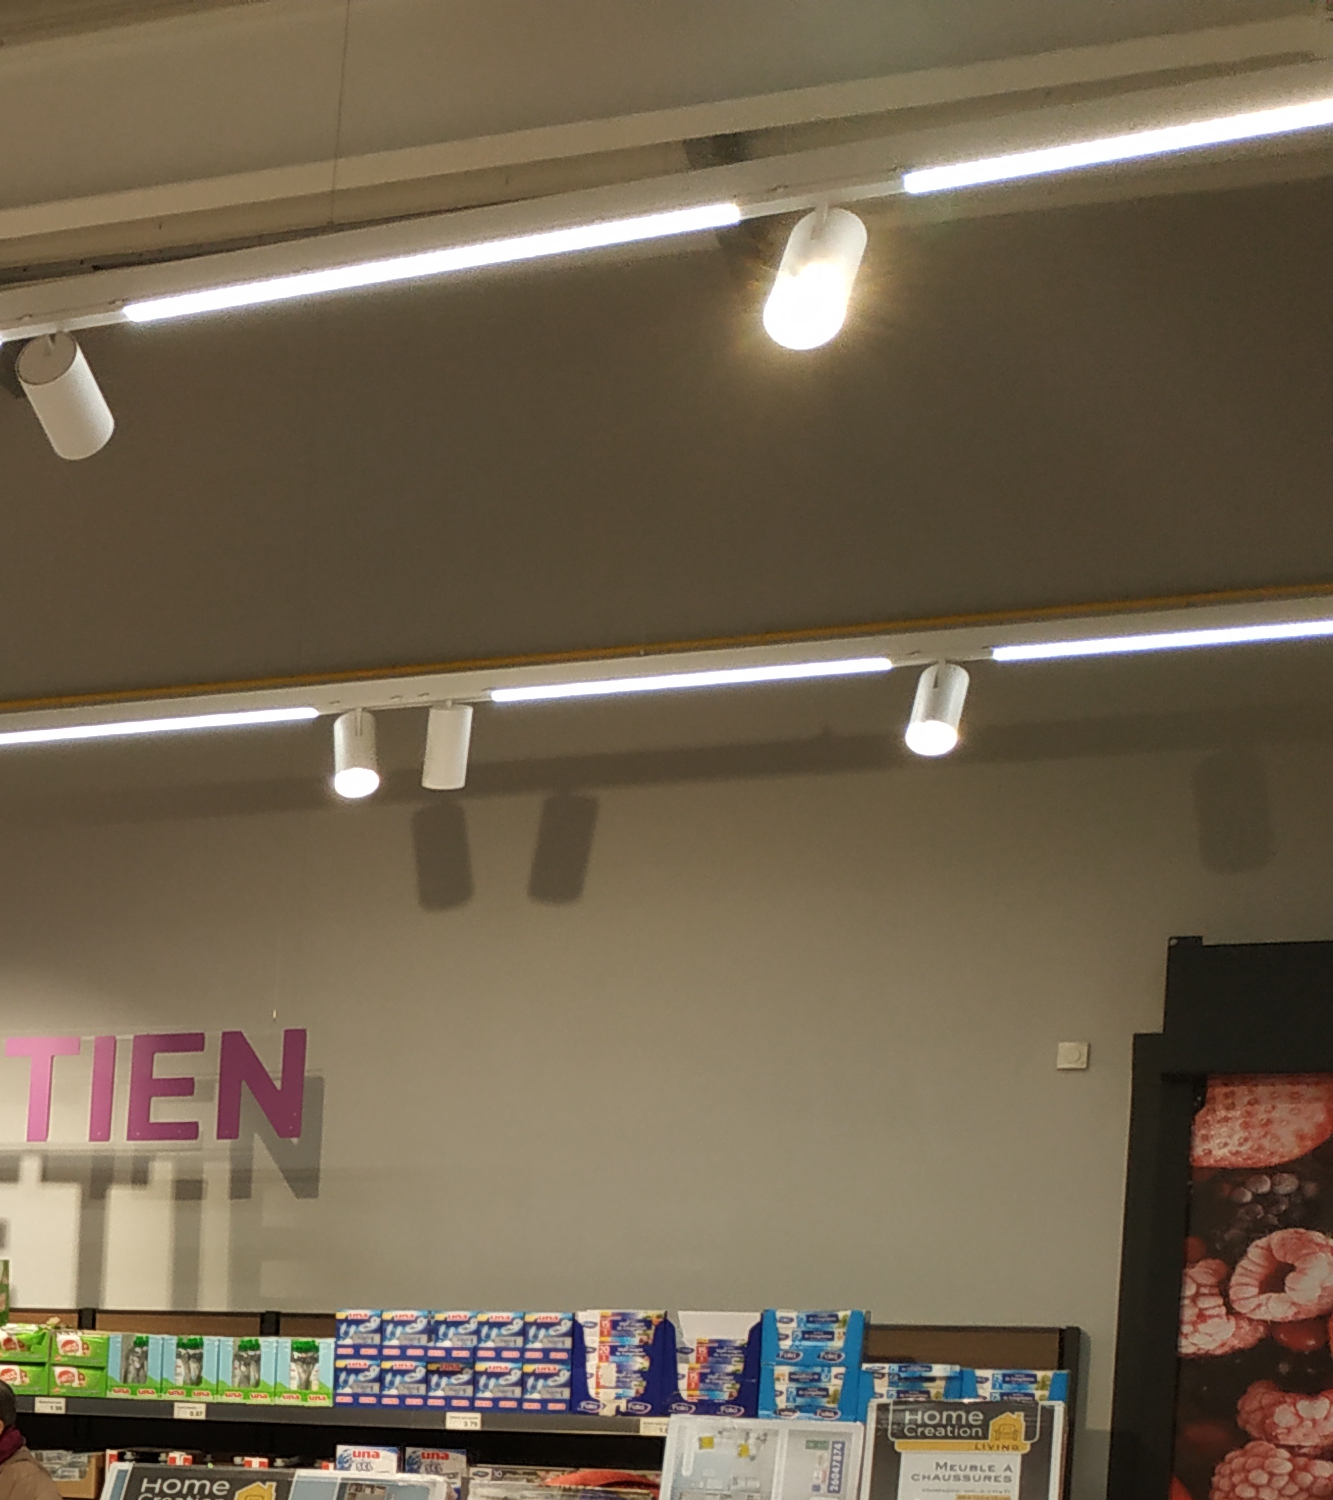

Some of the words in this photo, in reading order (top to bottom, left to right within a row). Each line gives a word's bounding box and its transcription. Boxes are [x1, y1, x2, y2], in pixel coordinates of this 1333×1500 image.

[904, 1409, 984, 1426] Home
[903, 1424, 983, 1438] Creation
[974, 1442, 1020, 1451] LIVING
[352, 1450, 381, 1460] una
[421, 1451, 450, 1461] una
[140, 1477, 231, 1496] Home
